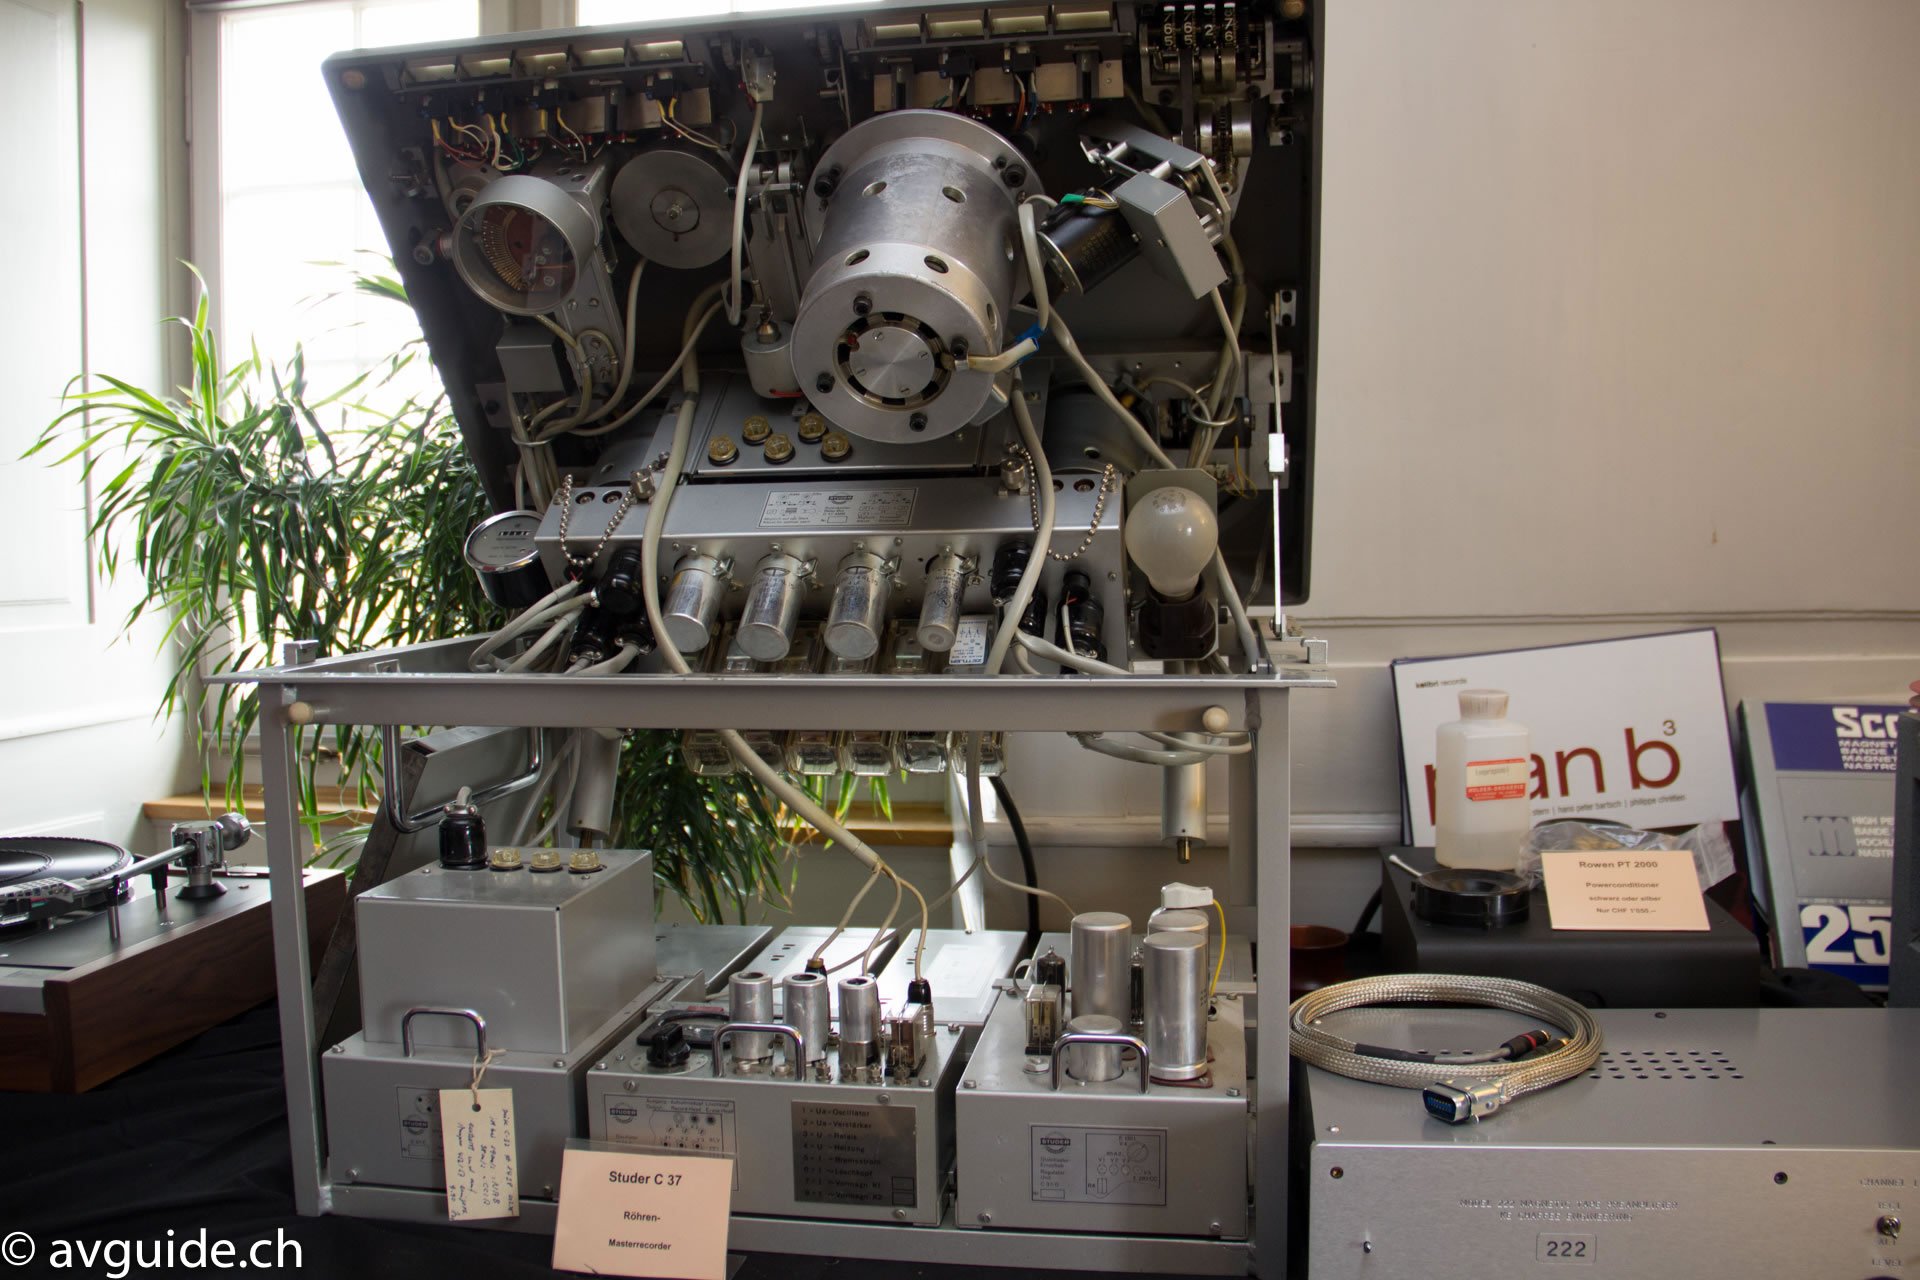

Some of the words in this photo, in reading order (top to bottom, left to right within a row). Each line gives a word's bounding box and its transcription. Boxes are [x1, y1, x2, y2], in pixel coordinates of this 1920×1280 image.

[1579, 861, 1615, 869] Rowen
[609, 1171, 651, 1185] Studer
[654, 1173, 664, 1186] C
[667, 1174, 682, 1187] 37
[623, 1210, 661, 1222] Röhren-
[608, 1238, 671, 1251] Masterrecorder
[1546, 1240, 1586, 1258] 222
